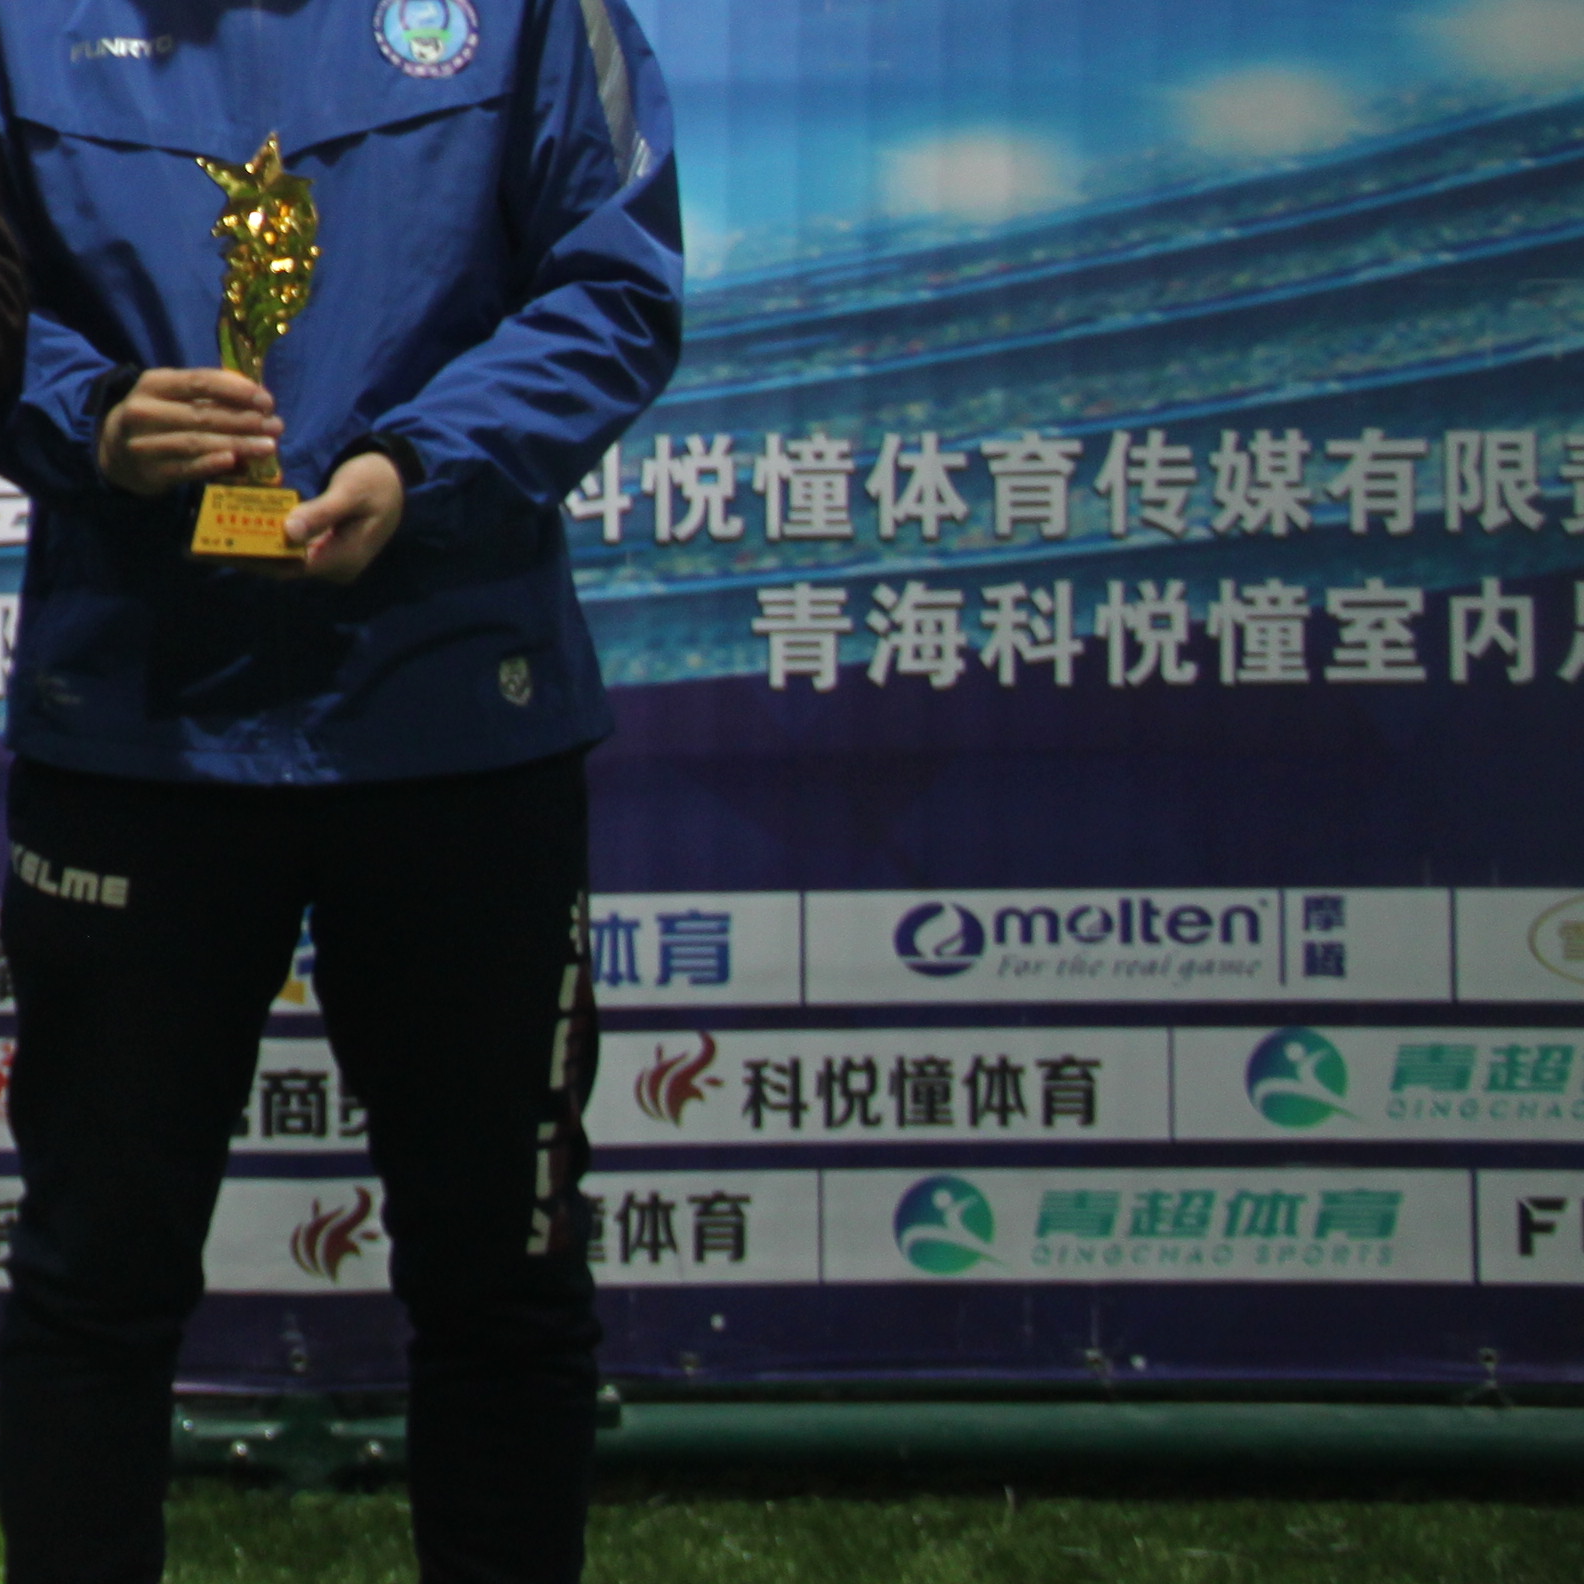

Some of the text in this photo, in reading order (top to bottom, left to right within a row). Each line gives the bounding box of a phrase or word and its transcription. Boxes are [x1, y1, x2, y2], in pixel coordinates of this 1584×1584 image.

[564, 428, 1584, 544] 科悦憧体育传媒有限
[752, 577, 1584, 691] 青海科悦憧室内
[993, 897, 1261, 945] molten
[742, 1055, 1102, 1129] 科悦憧体育
[1035, 1189, 1404, 1239] 青超体育
[1034, 1245, 1394, 1266] QINGCHAO SPORTS
